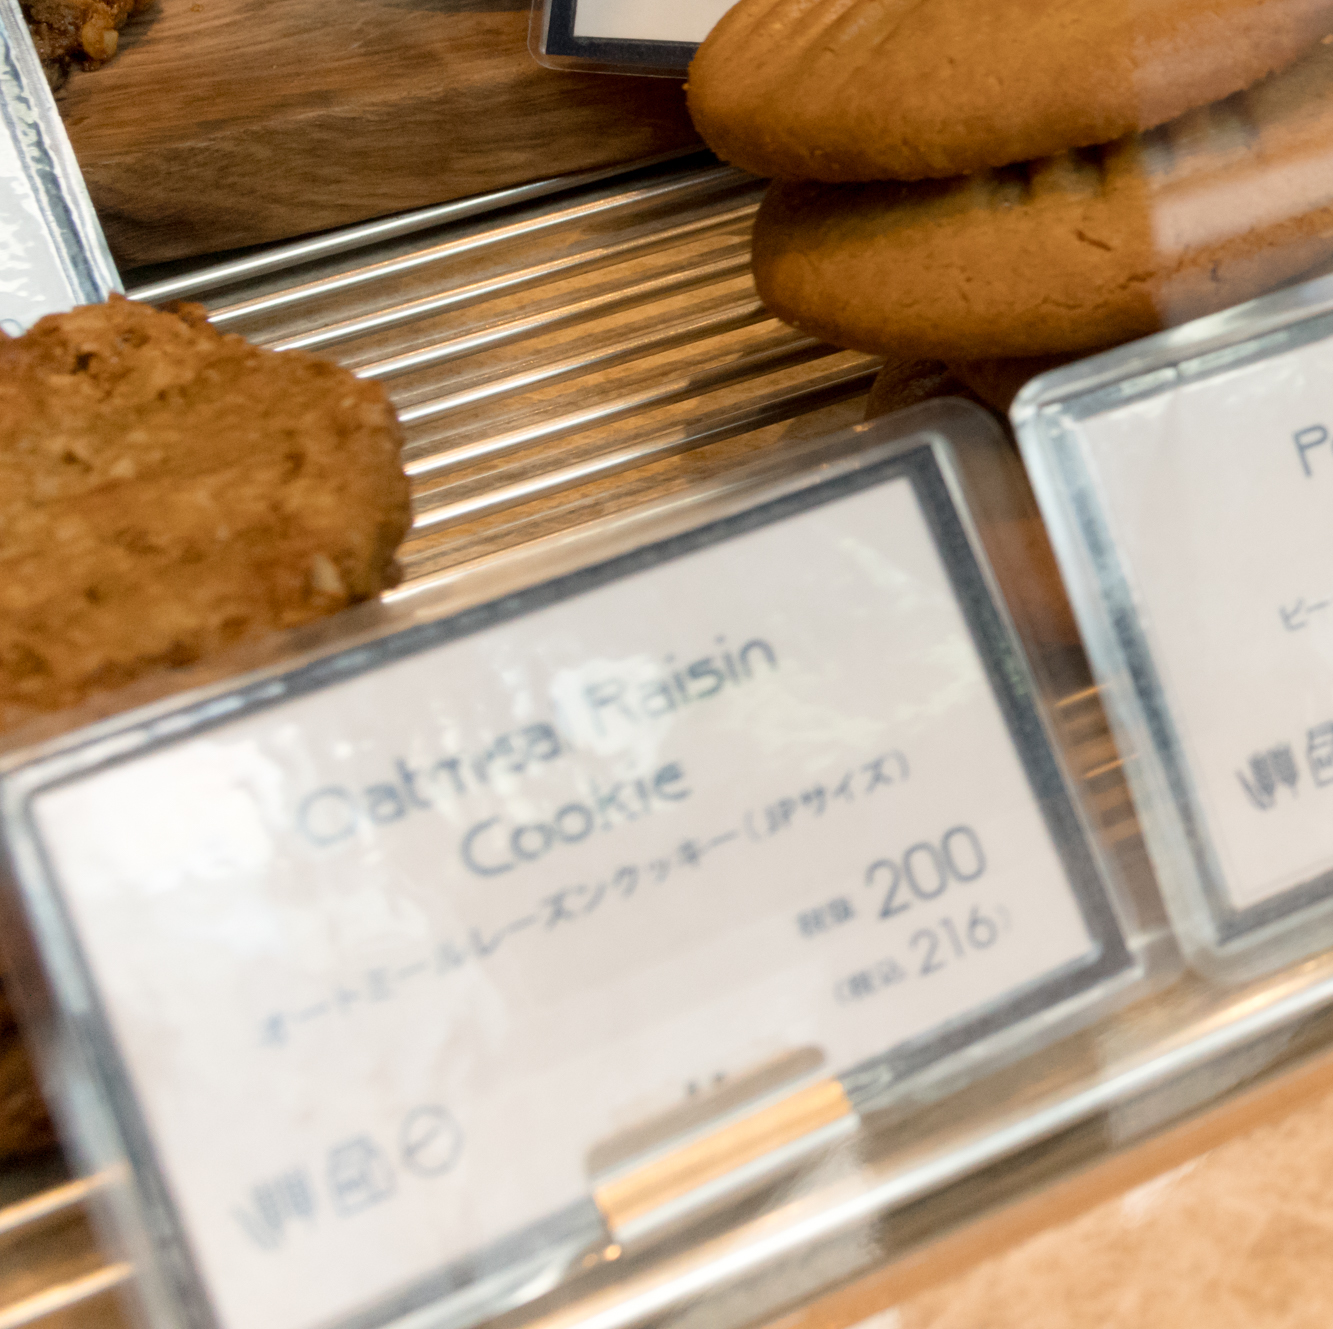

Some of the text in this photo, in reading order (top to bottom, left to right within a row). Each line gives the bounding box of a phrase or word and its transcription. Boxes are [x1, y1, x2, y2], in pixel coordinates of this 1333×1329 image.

[585, 635, 779, 738] Raisin
[460, 759, 692, 877] Cookie
[865, 823, 988, 921] 200
